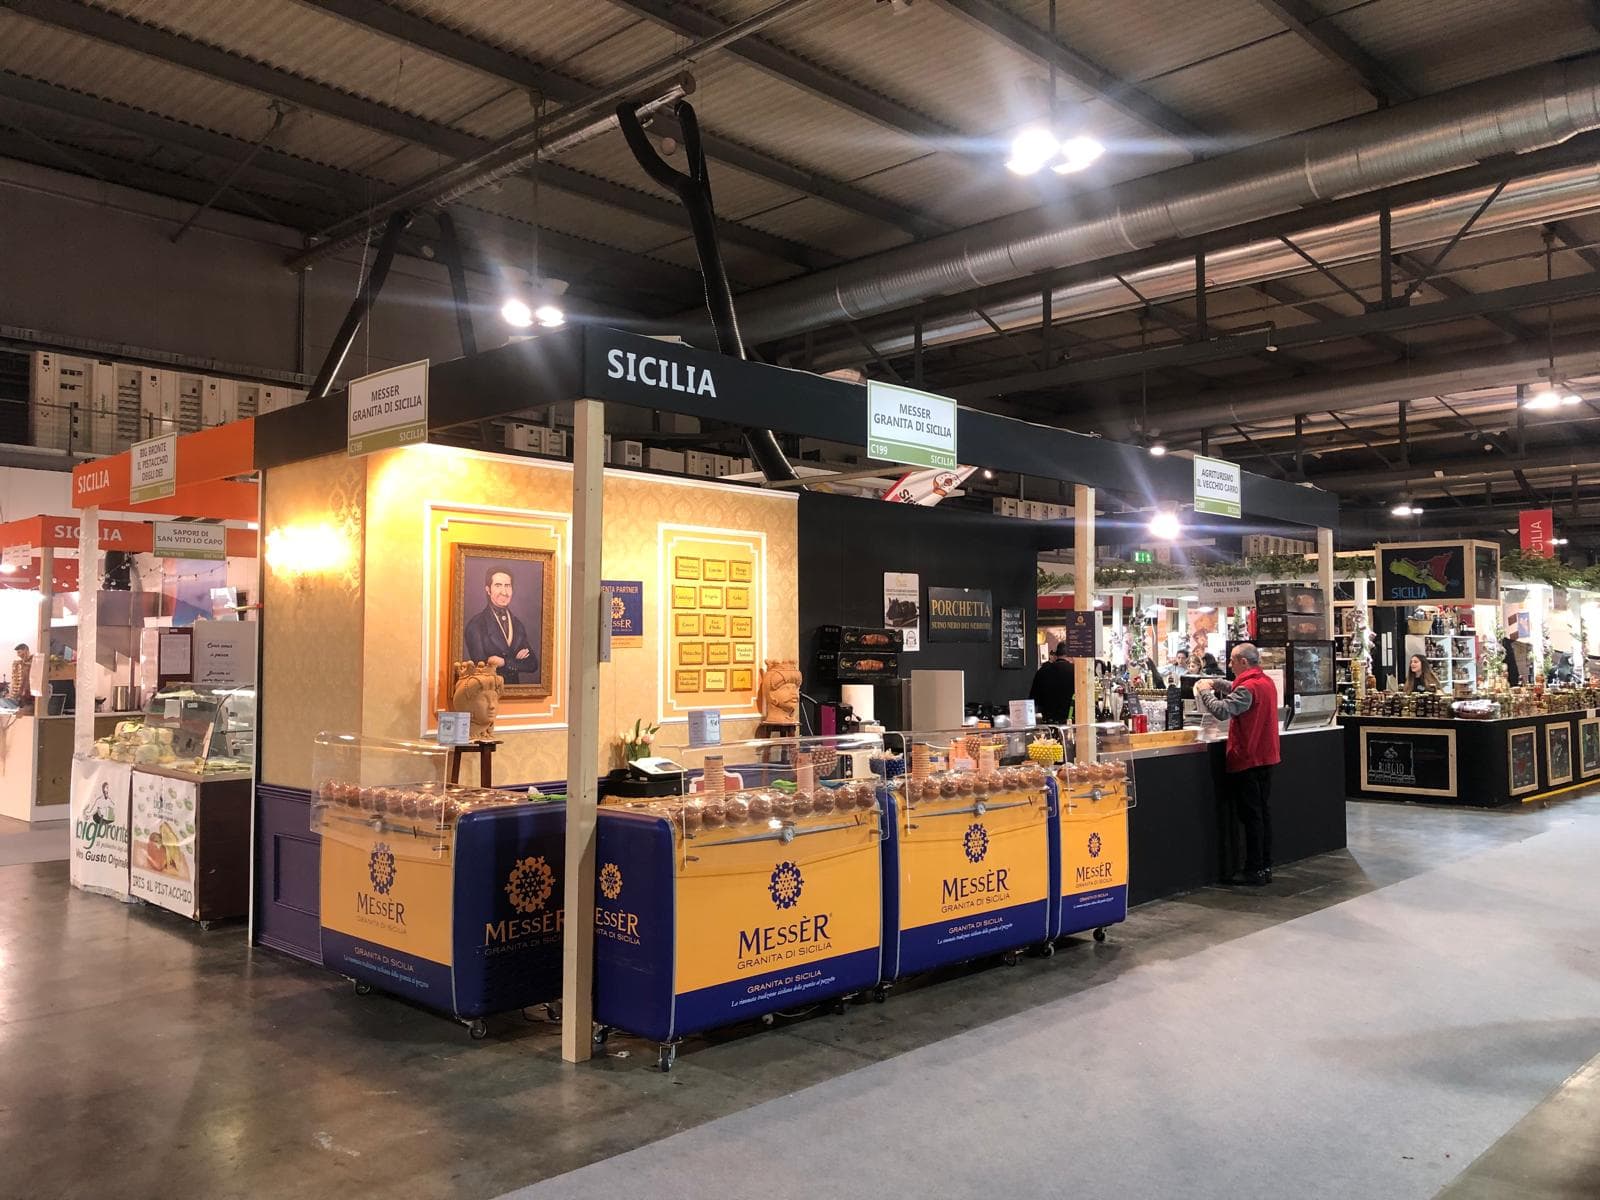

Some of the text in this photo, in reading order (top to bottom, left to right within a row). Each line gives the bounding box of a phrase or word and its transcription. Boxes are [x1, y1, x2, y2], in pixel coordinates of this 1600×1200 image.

[608, 349, 717, 398] SICILIA
[371, 384, 400, 402] MESSER
[352, 394, 422, 422] GRANITA DI SICILIA
[899, 403, 931, 420] MESSER
[400, 428, 425, 441] SICILIA
[873, 413, 952, 439] GRANITA DI SICILIA
[871, 444, 954, 467] C199 SICILIA
[78, 469, 110, 494] SICILIA
[173, 529, 200, 537] SAPORI
[1391, 586, 1428, 600] SICILIA
[931, 599, 992, 617] PORCHETTA
[947, 621, 961, 629] NERO
[85, 851, 107, 862] Gusto
[154, 881, 193, 904] PISTACCHIO
[941, 892, 1010, 914] GRANITA DI SICILIA
[595, 907, 640, 938] ESSÈR
[948, 923, 975, 934] GRANITA
[983, 917, 1003, 926] SICILIA
[484, 942, 528, 956] GRANITA
[616, 933, 641, 946] SICILIA
[354, 946, 382, 961] GRANITA
[382, 955, 390, 964] DI
[390, 958, 414, 972] SICILIA
[737, 942, 832, 970] GRANITA DI SICILIA
[747, 969, 822, 994] GRANITA DI SICILIA
